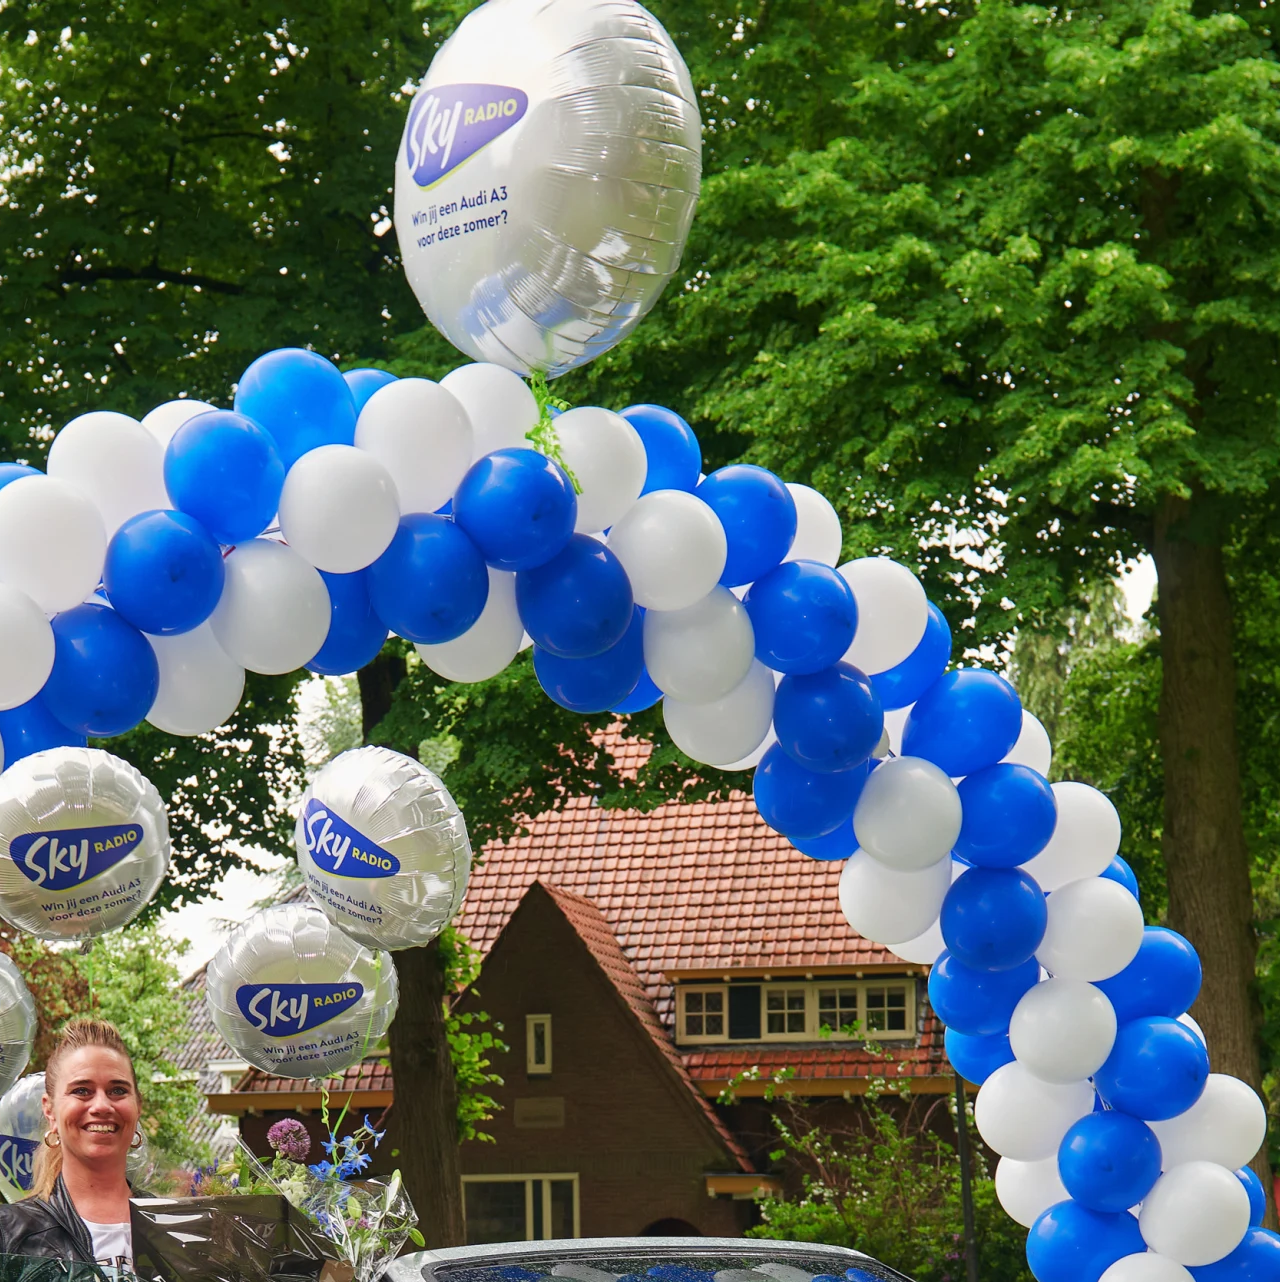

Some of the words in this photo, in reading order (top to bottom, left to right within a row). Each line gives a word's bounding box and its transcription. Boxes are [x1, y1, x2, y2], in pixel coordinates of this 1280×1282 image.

[410, 95, 463, 177] Sky
[464, 98, 517, 126] RADIO
[412, 211, 428, 227] Win
[428, 205, 438, 225] jij
[439, 200, 458, 218] een
[460, 190, 487, 211] Audi
[490, 185, 508, 203] A3
[417, 232, 436, 248] voor
[437, 225, 461, 242] deze
[463, 209, 508, 234] zomer?
[24, 836, 89, 885] Sky
[93, 830, 138, 853] RADIO
[307, 810, 352, 870] Sky
[352, 847, 392, 870] RADIO
[41, 902, 64, 912] Win
[66, 898, 77, 909] jij
[79, 894, 100, 905] een
[101, 884, 126, 899] Audi
[128, 878, 141, 890] A3
[48, 912, 75, 922] voor
[76, 905, 102, 917] deze
[104, 889, 142, 909] zomer?
[307, 872, 321, 886] Win
[321, 881, 330, 894] jij
[330, 888, 345, 900] een
[346, 895, 367, 910] Audi
[369, 903, 383, 915] A3
[310, 888, 326, 900] voor
[327, 898, 346, 912] deze
[348, 910, 383, 926] zomer?
[248, 988, 309, 1031] Sky
[313, 988, 356, 1008] RADIO
[263, 1046, 284, 1055] Win
[286, 1045, 296, 1055] jij
[298, 1042, 318, 1052] een
[319, 1036, 344, 1048] Audi
[345, 1031, 360, 1042] A3
[270, 1055, 294, 1064] voor
[296, 1050, 320, 1061] deze
[323, 1041, 360, 1057] zomer?
